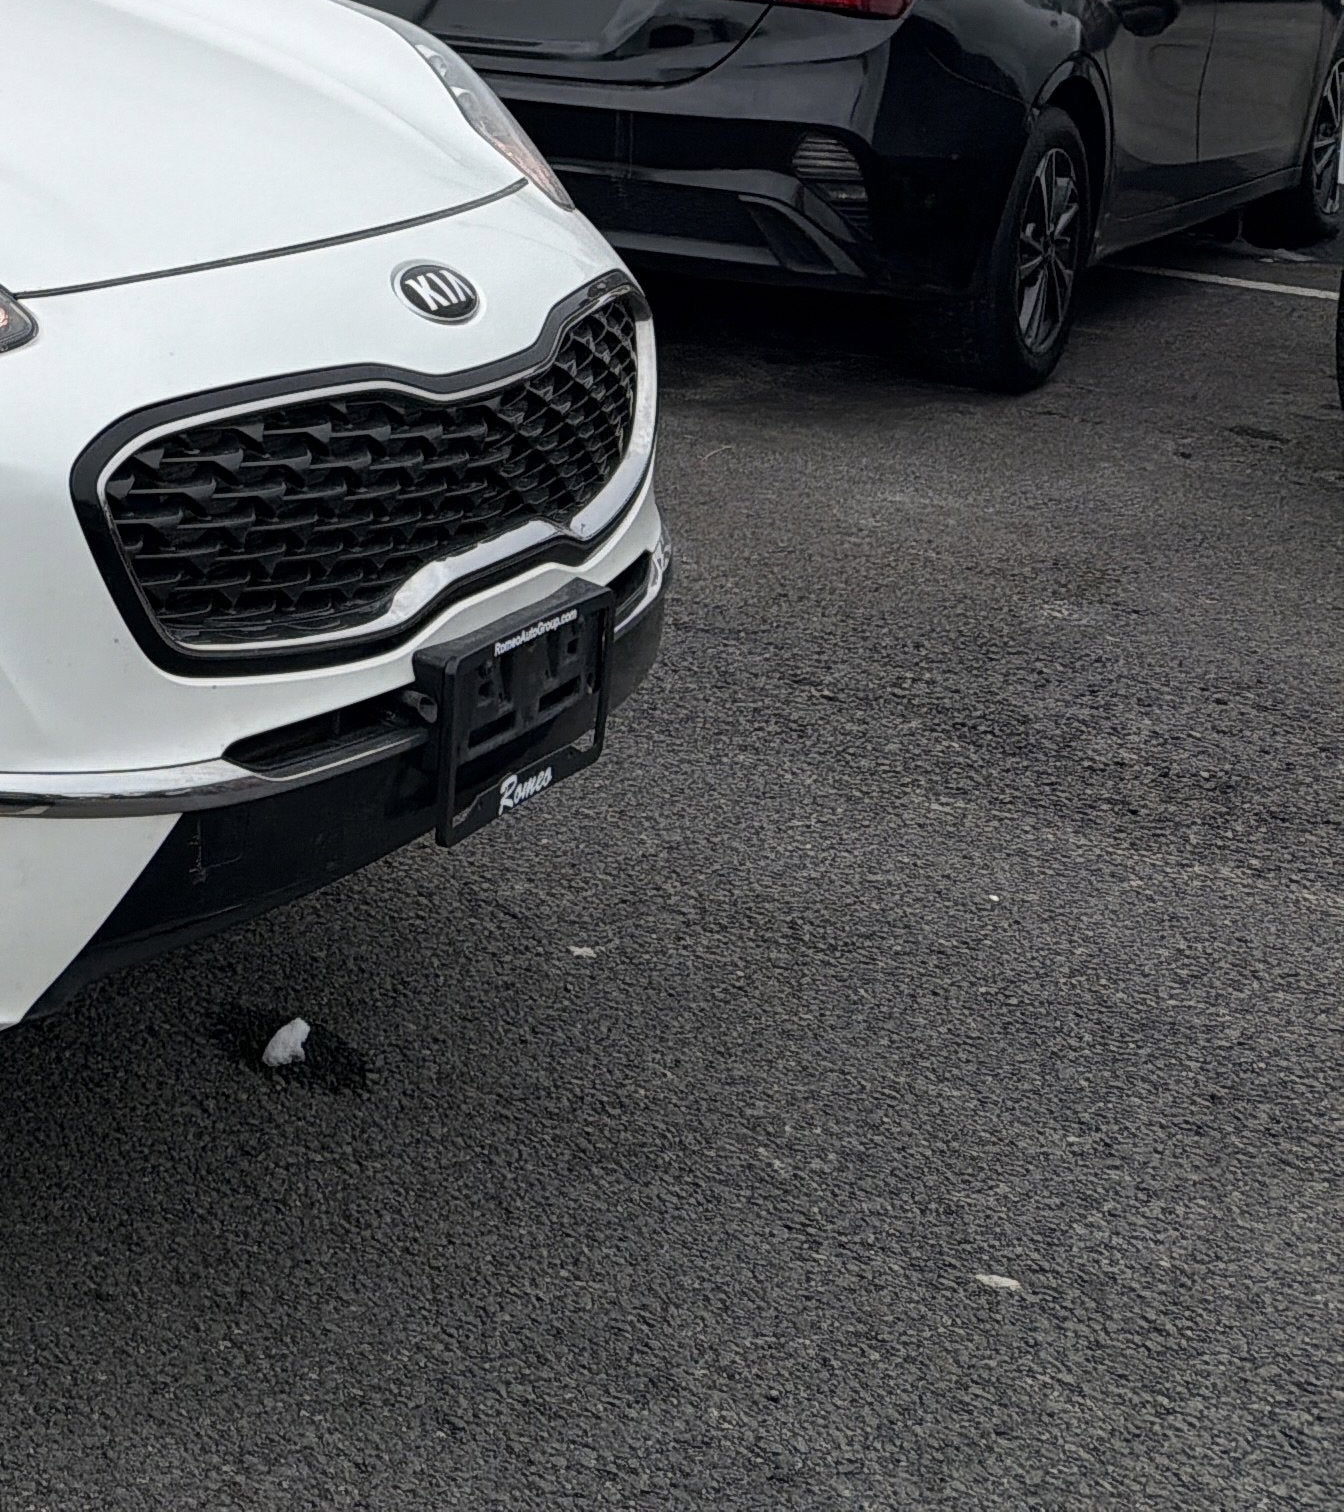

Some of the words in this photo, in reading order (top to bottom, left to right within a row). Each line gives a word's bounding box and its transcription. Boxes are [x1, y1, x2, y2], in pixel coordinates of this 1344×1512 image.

[404, 269, 476, 311] KIA
[494, 608, 578, 657] RomeoAutoGroup.com
[498, 766, 553, 816] Romeo
